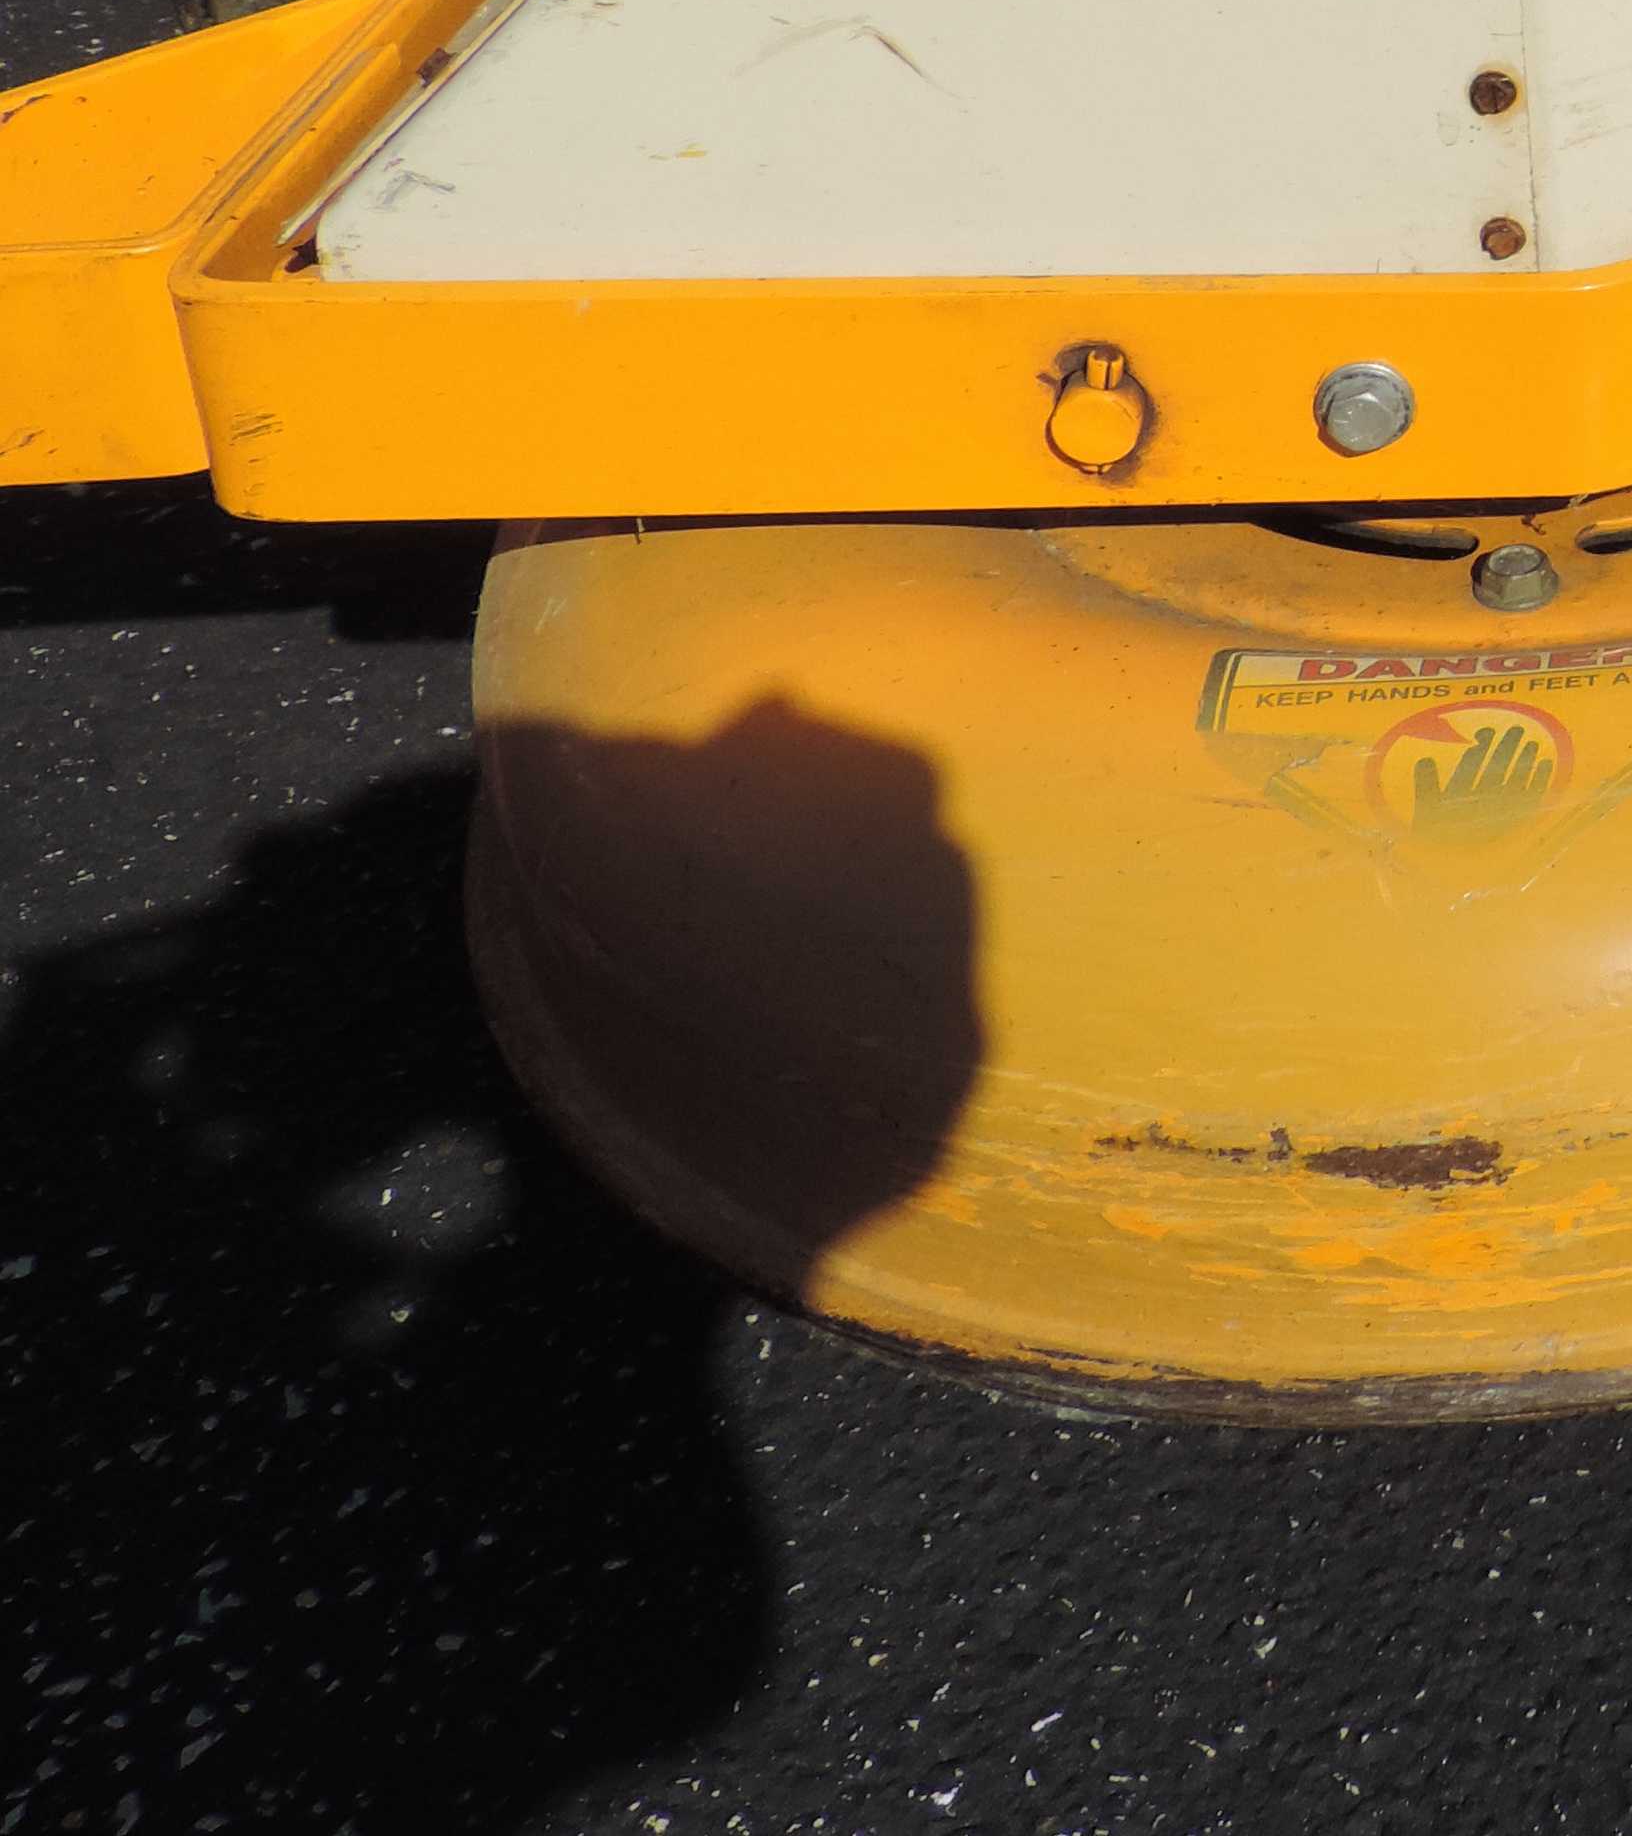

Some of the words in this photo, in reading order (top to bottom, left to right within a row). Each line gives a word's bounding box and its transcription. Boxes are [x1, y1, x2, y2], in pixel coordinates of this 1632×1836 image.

[1255, 690, 1334, 709] KEEP
[1347, 684, 1451, 703] HANDS
[1464, 680, 1515, 696] and
[1528, 673, 1600, 692] FEET
